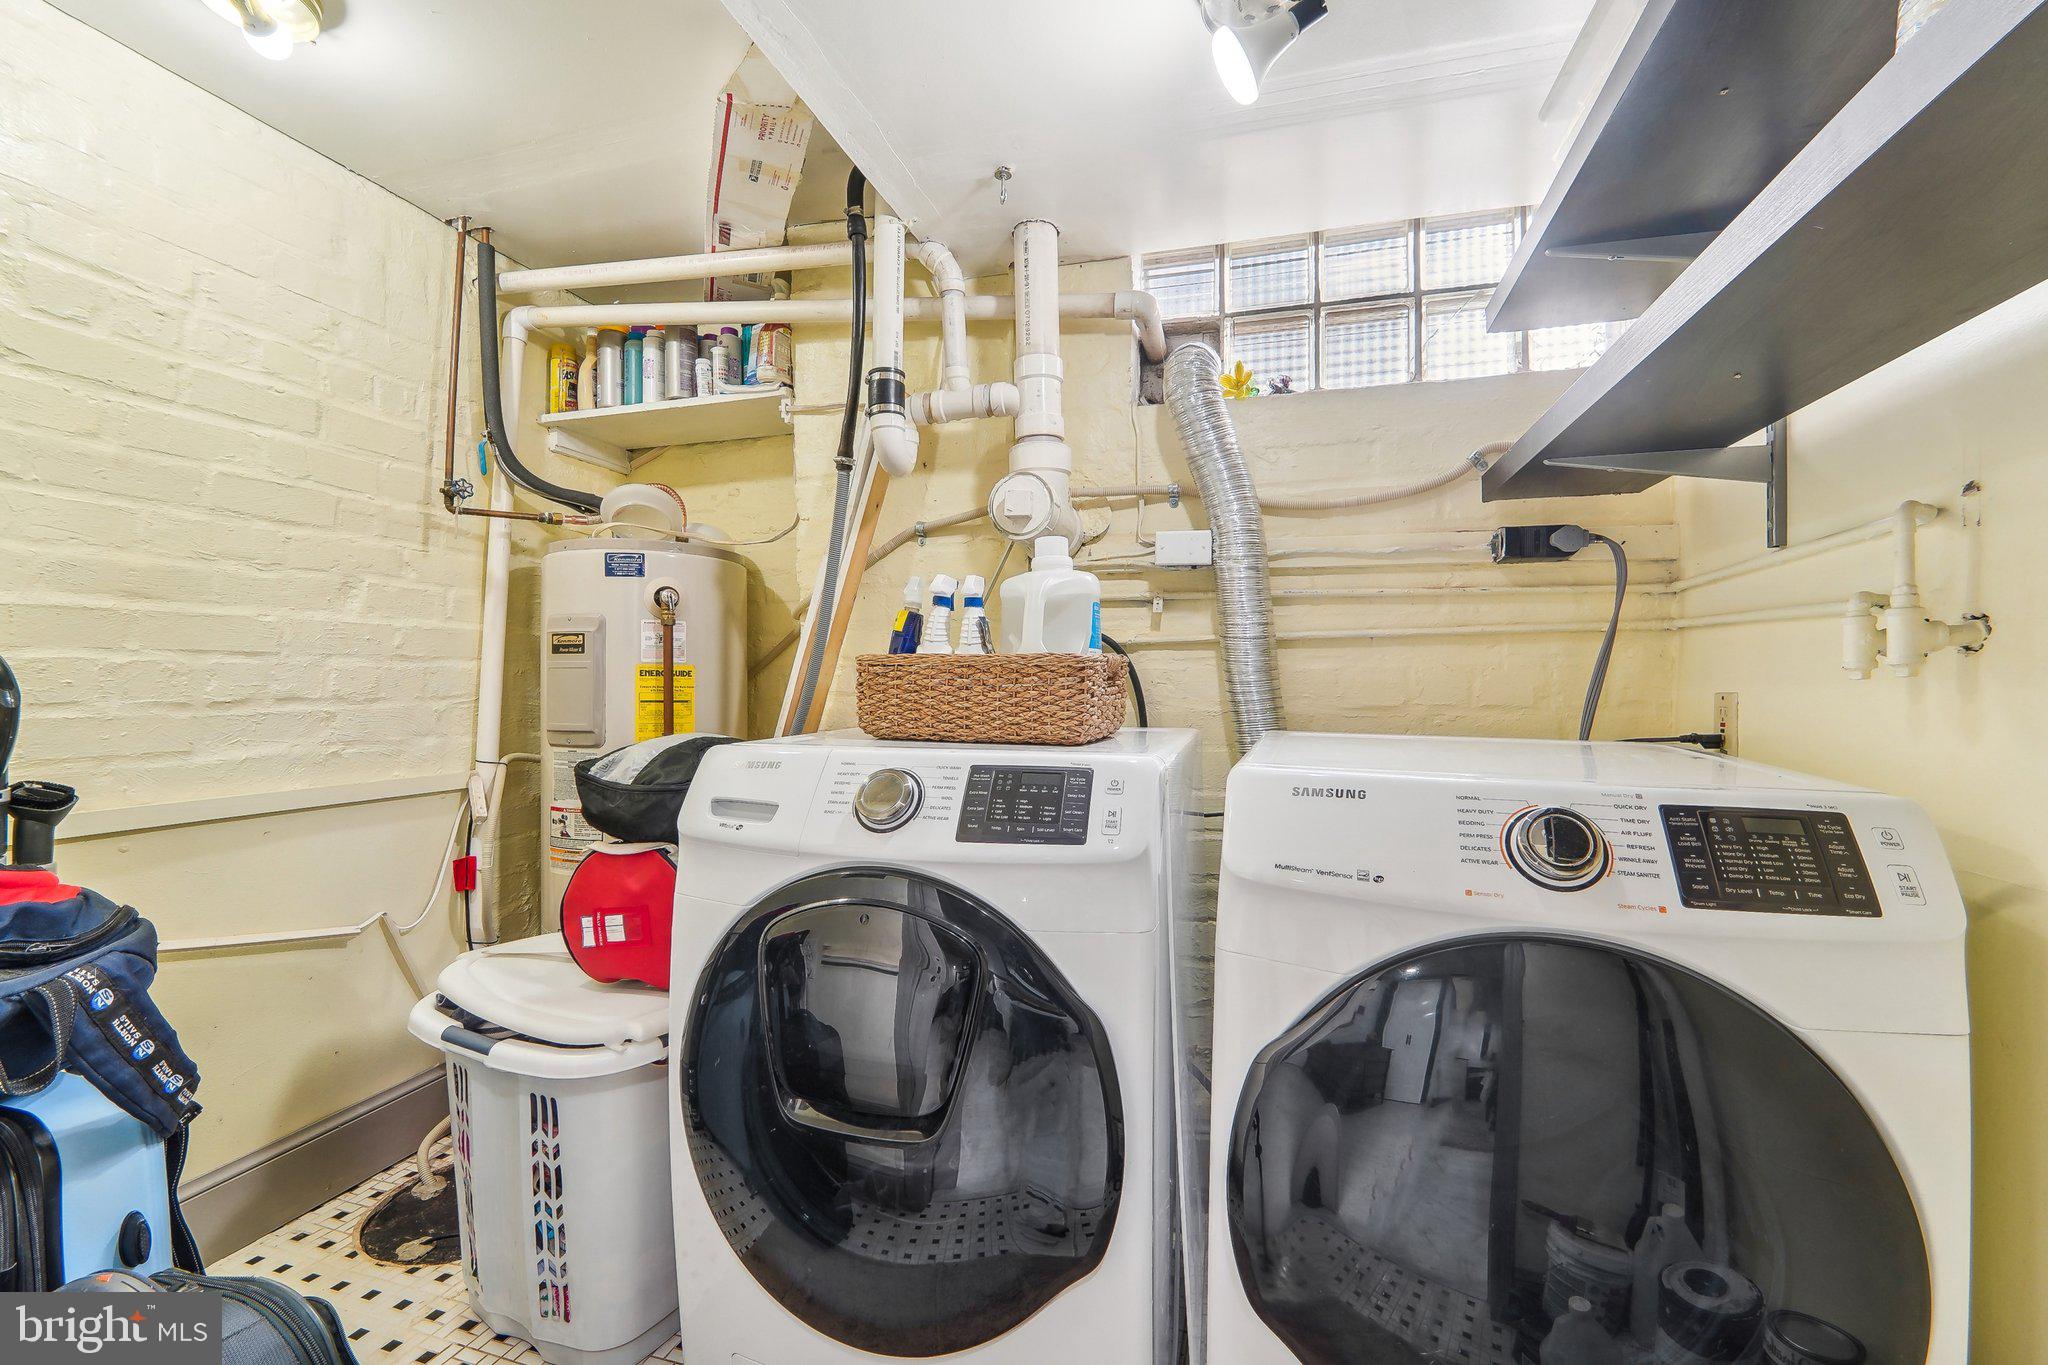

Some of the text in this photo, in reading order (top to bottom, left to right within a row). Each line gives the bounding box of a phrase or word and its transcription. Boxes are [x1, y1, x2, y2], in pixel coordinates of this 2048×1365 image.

[758, 113, 769, 141] PRIORITY
[1292, 787, 1367, 799] SAMSUNG
[1316, 869, 1353, 880] VentSensor
[112, 1018, 138, 1047] NORTH
[120, 1014, 142, 1038] SAILS
